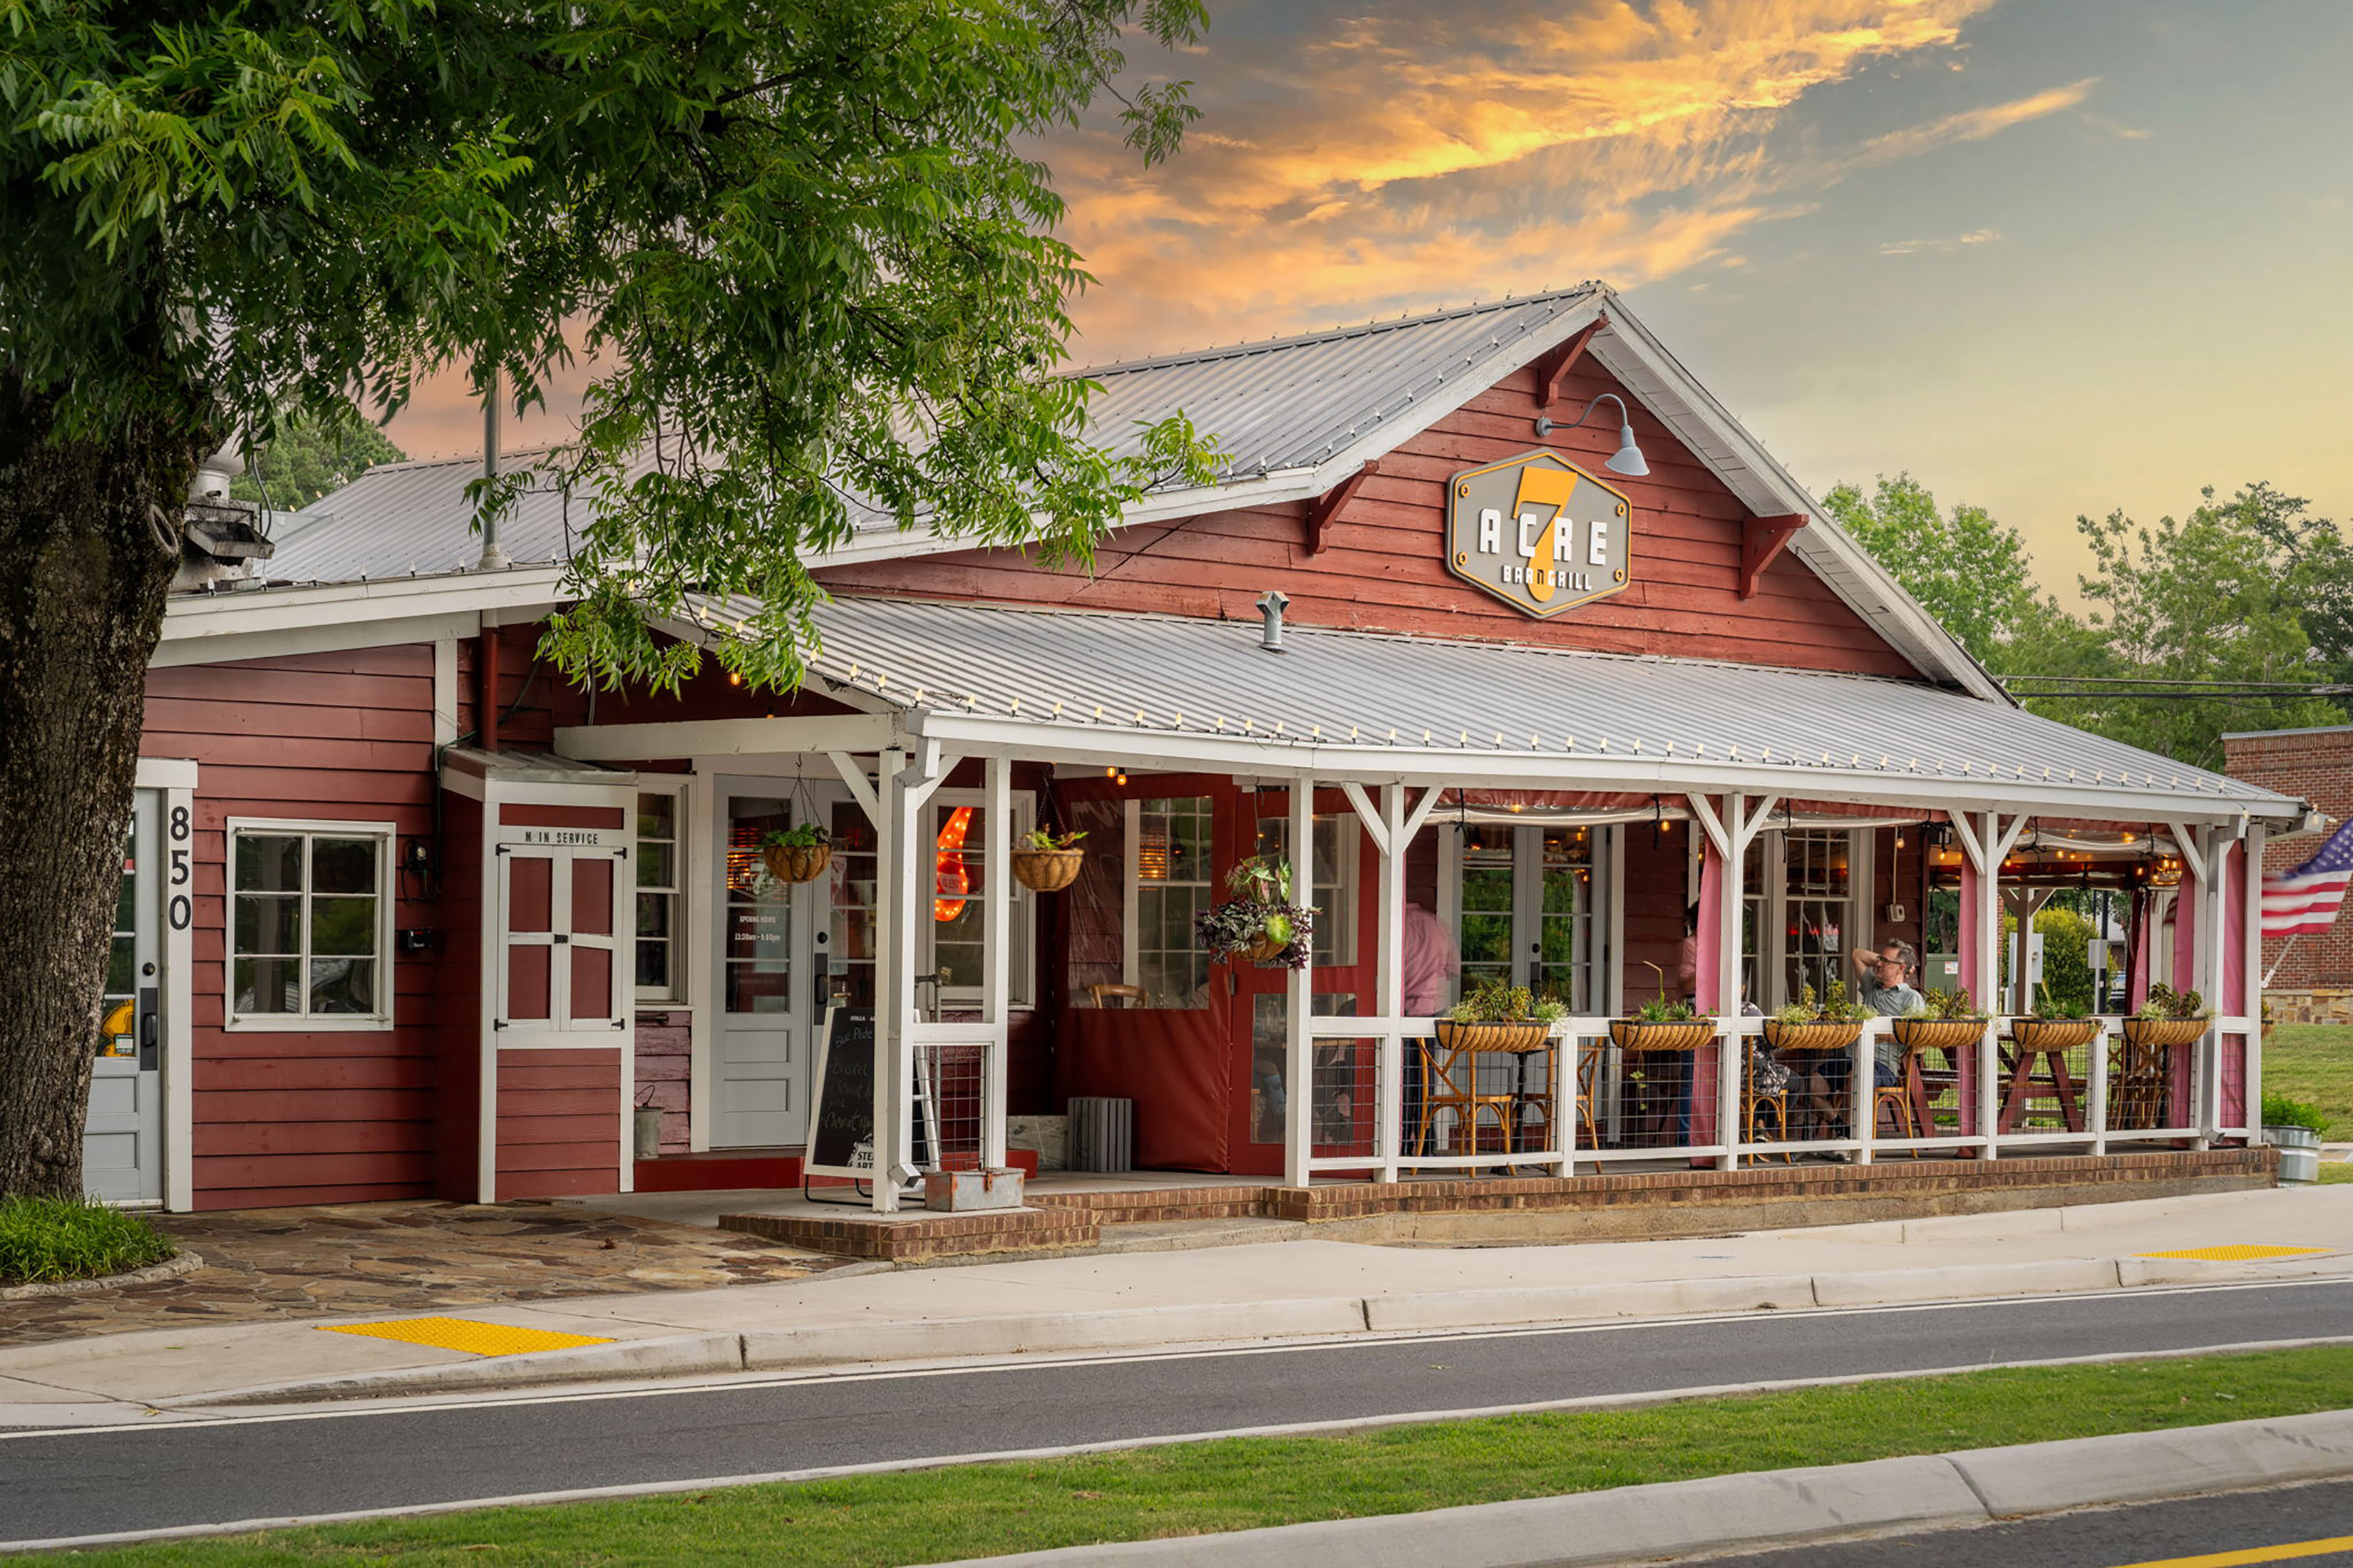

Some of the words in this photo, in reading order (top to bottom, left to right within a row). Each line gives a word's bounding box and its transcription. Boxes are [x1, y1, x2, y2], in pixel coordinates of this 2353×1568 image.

[1479, 508, 1608, 565] ACRE
[1513, 466, 1578, 602] 7
[1502, 564, 1533, 584] BAR
[1548, 569, 1592, 591] GRILL
[557, 832, 598, 845] SERVICE
[169, 805, 192, 931] 850
[858, 1151, 874, 1161] STE
